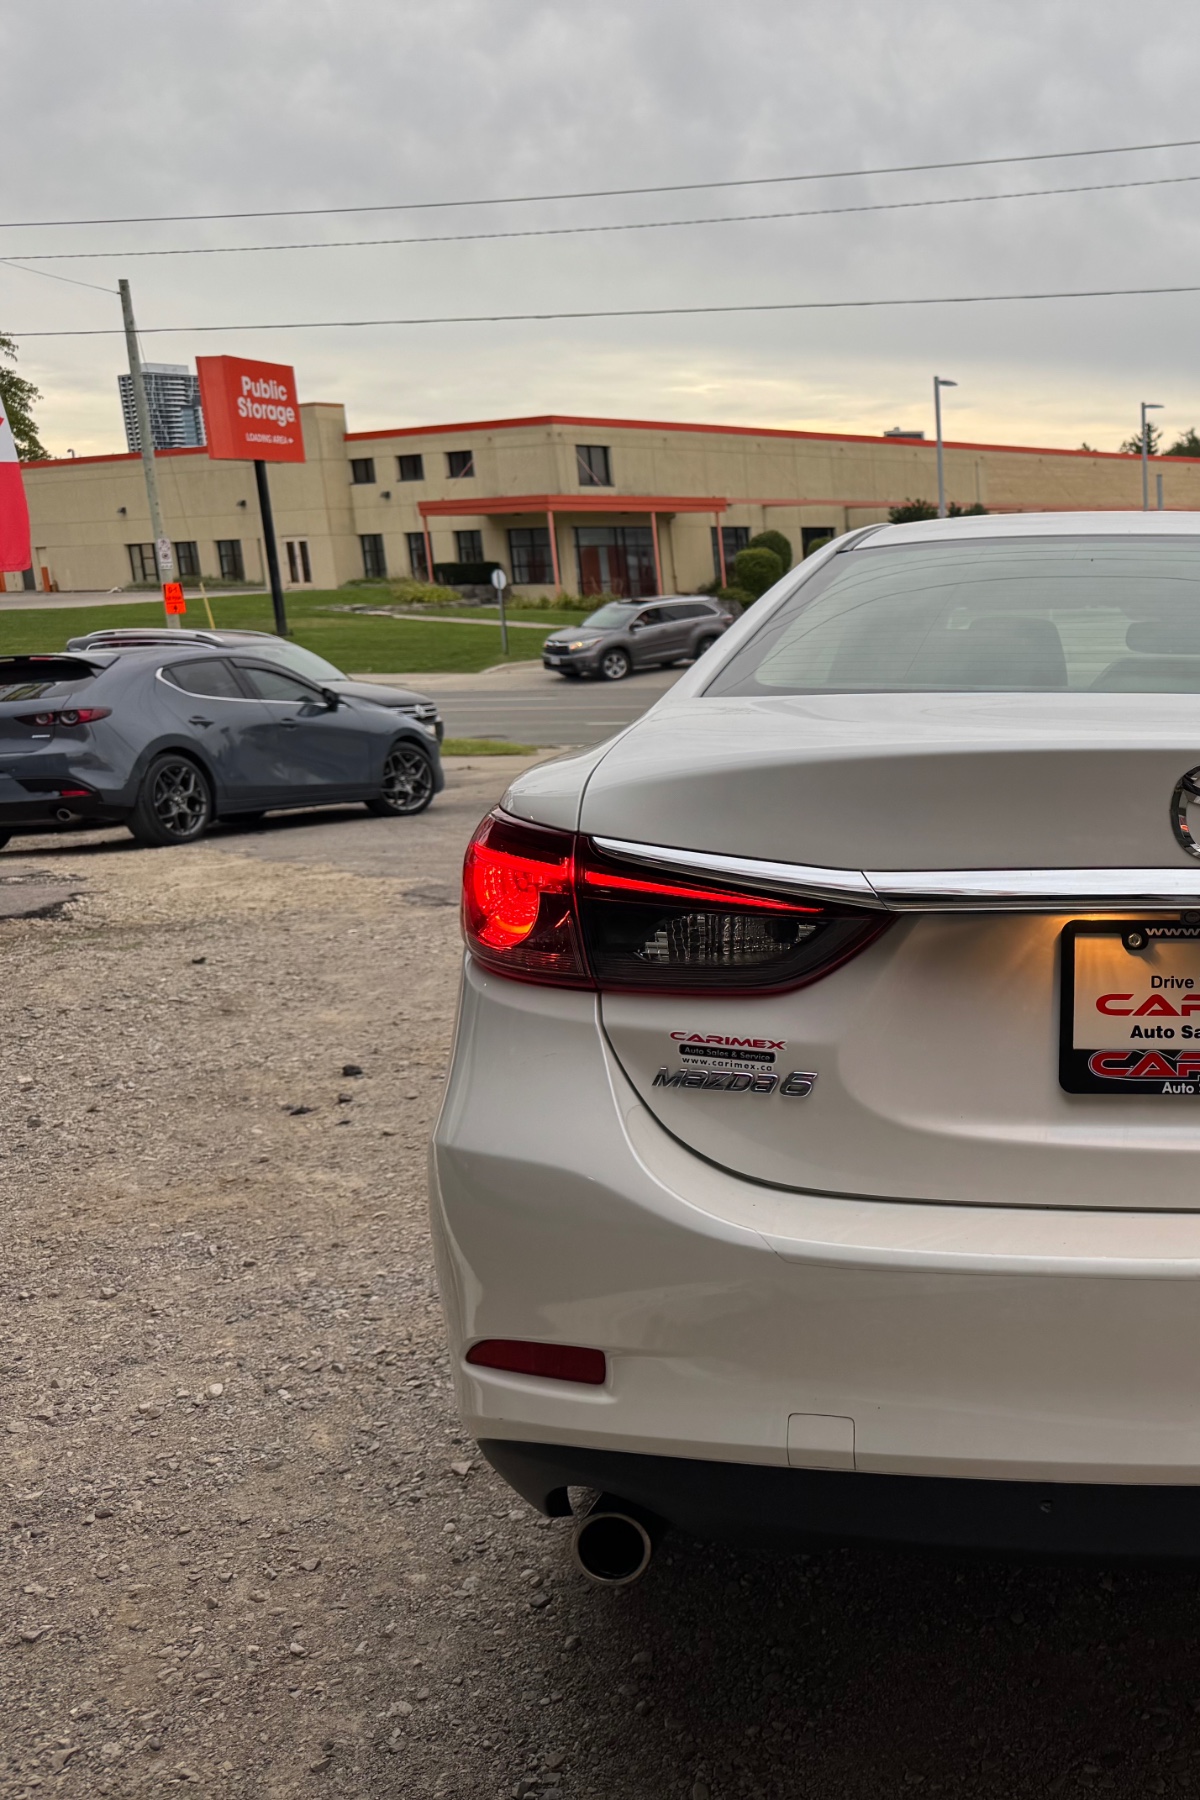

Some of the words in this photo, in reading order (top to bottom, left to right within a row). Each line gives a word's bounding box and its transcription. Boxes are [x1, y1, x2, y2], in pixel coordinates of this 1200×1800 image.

[241, 375, 288, 401] Public
[237, 396, 295, 427] Storage
[1151, 975, 1194, 989] Drive
[1130, 1024, 1175, 1039] Auto
[670, 1031, 786, 1050] CARIMEX
[684, 1046, 704, 1055] Auto
[706, 1048, 729, 1057] Sales
[740, 1051, 771, 1061] Service
[682, 1057, 772, 1072] www.carimex.ca
[1162, 1081, 1194, 1094] Auto
